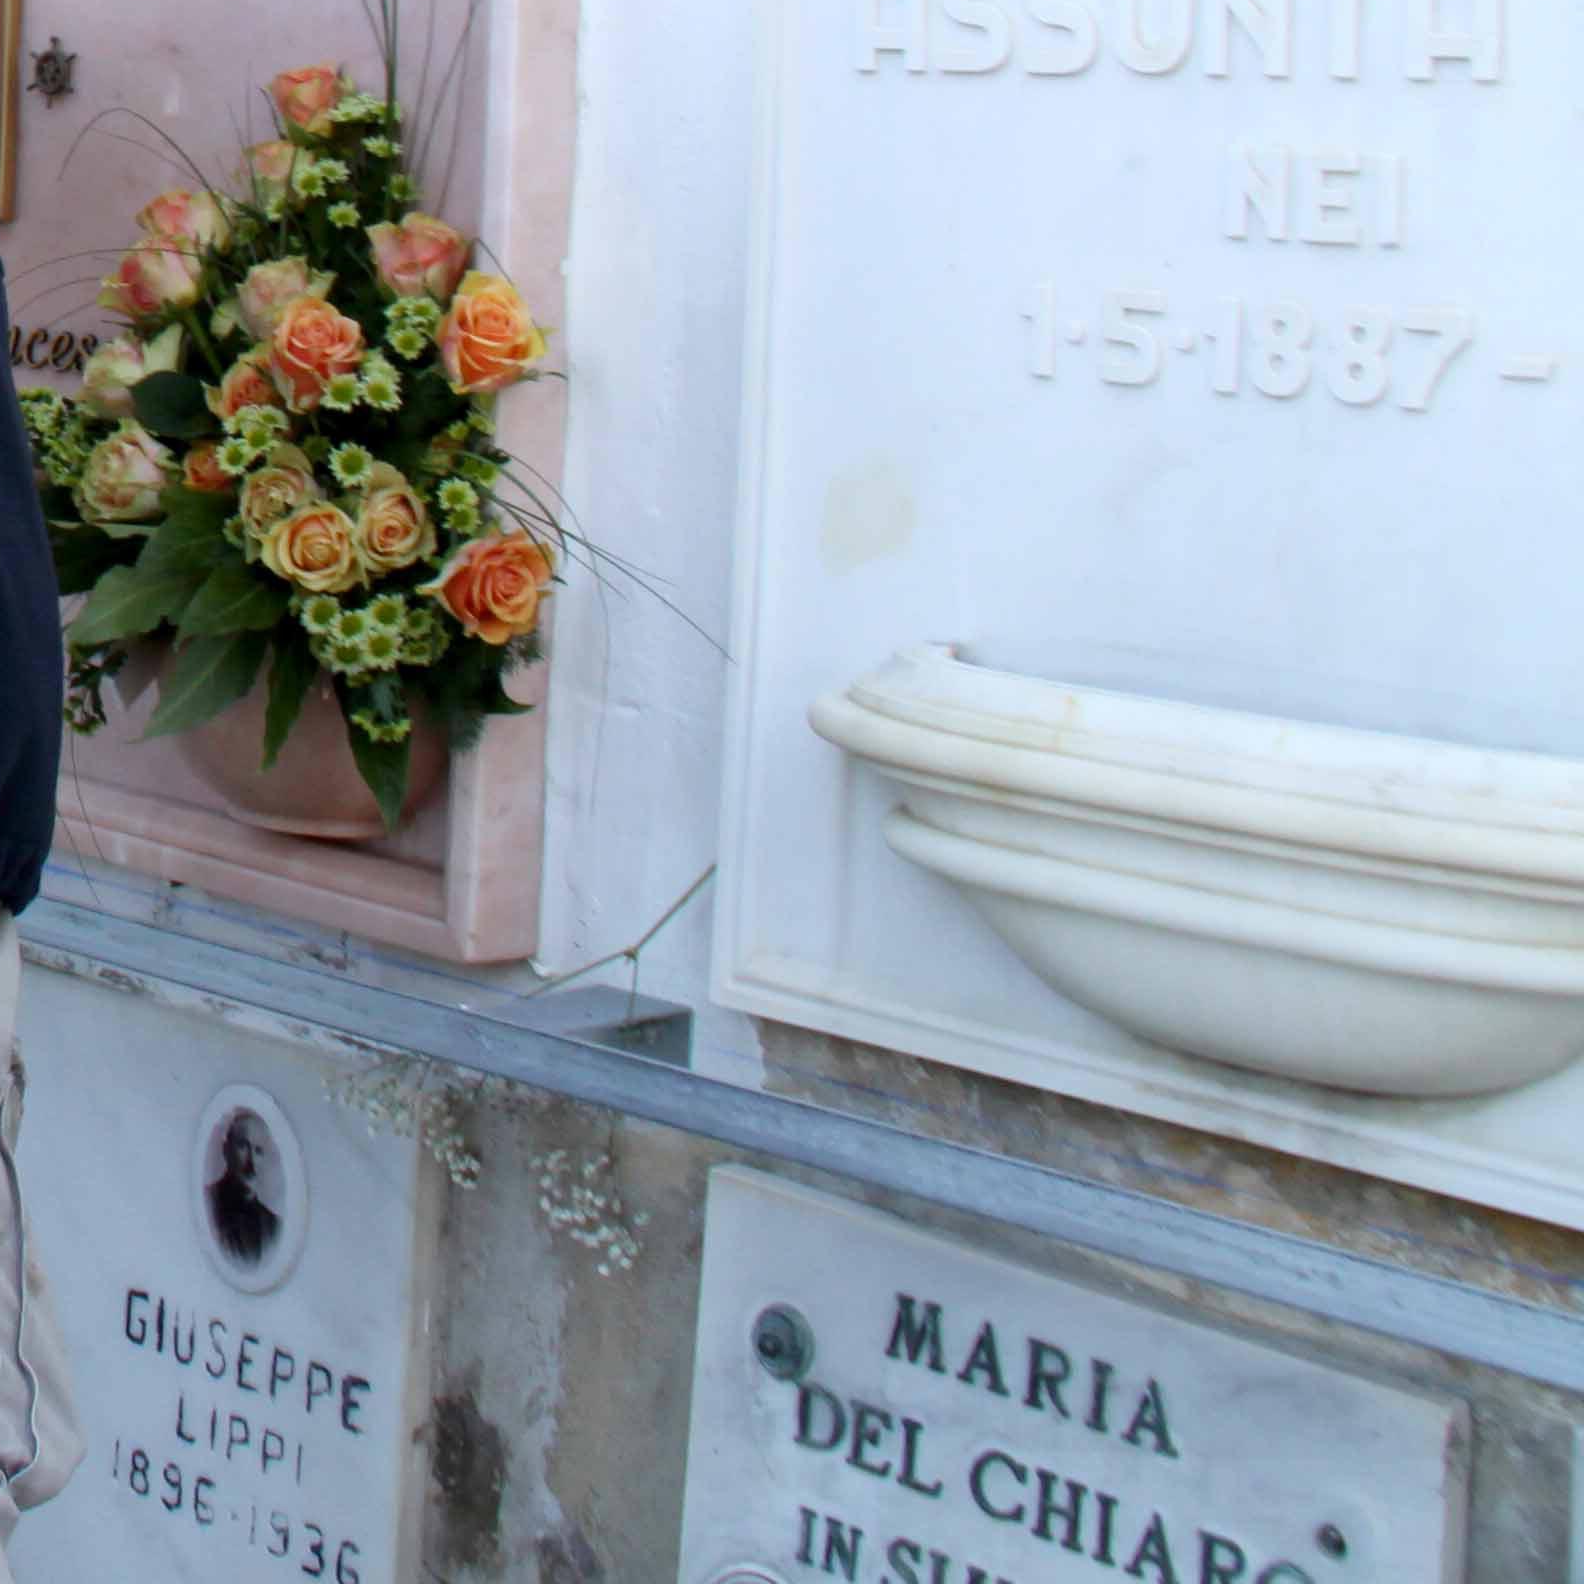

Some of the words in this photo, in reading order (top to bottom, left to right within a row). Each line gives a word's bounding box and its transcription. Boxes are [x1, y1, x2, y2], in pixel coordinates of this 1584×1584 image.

[1224, 144, 1407, 249] NEI
[124, 1288, 372, 1434] GIUSEPPE
[884, 1292, 1180, 1458] MARIA
[175, 1390, 304, 1486] LIPPI
[793, 1382, 943, 1500] DEL
[795, 1504, 863, 1584] IN
